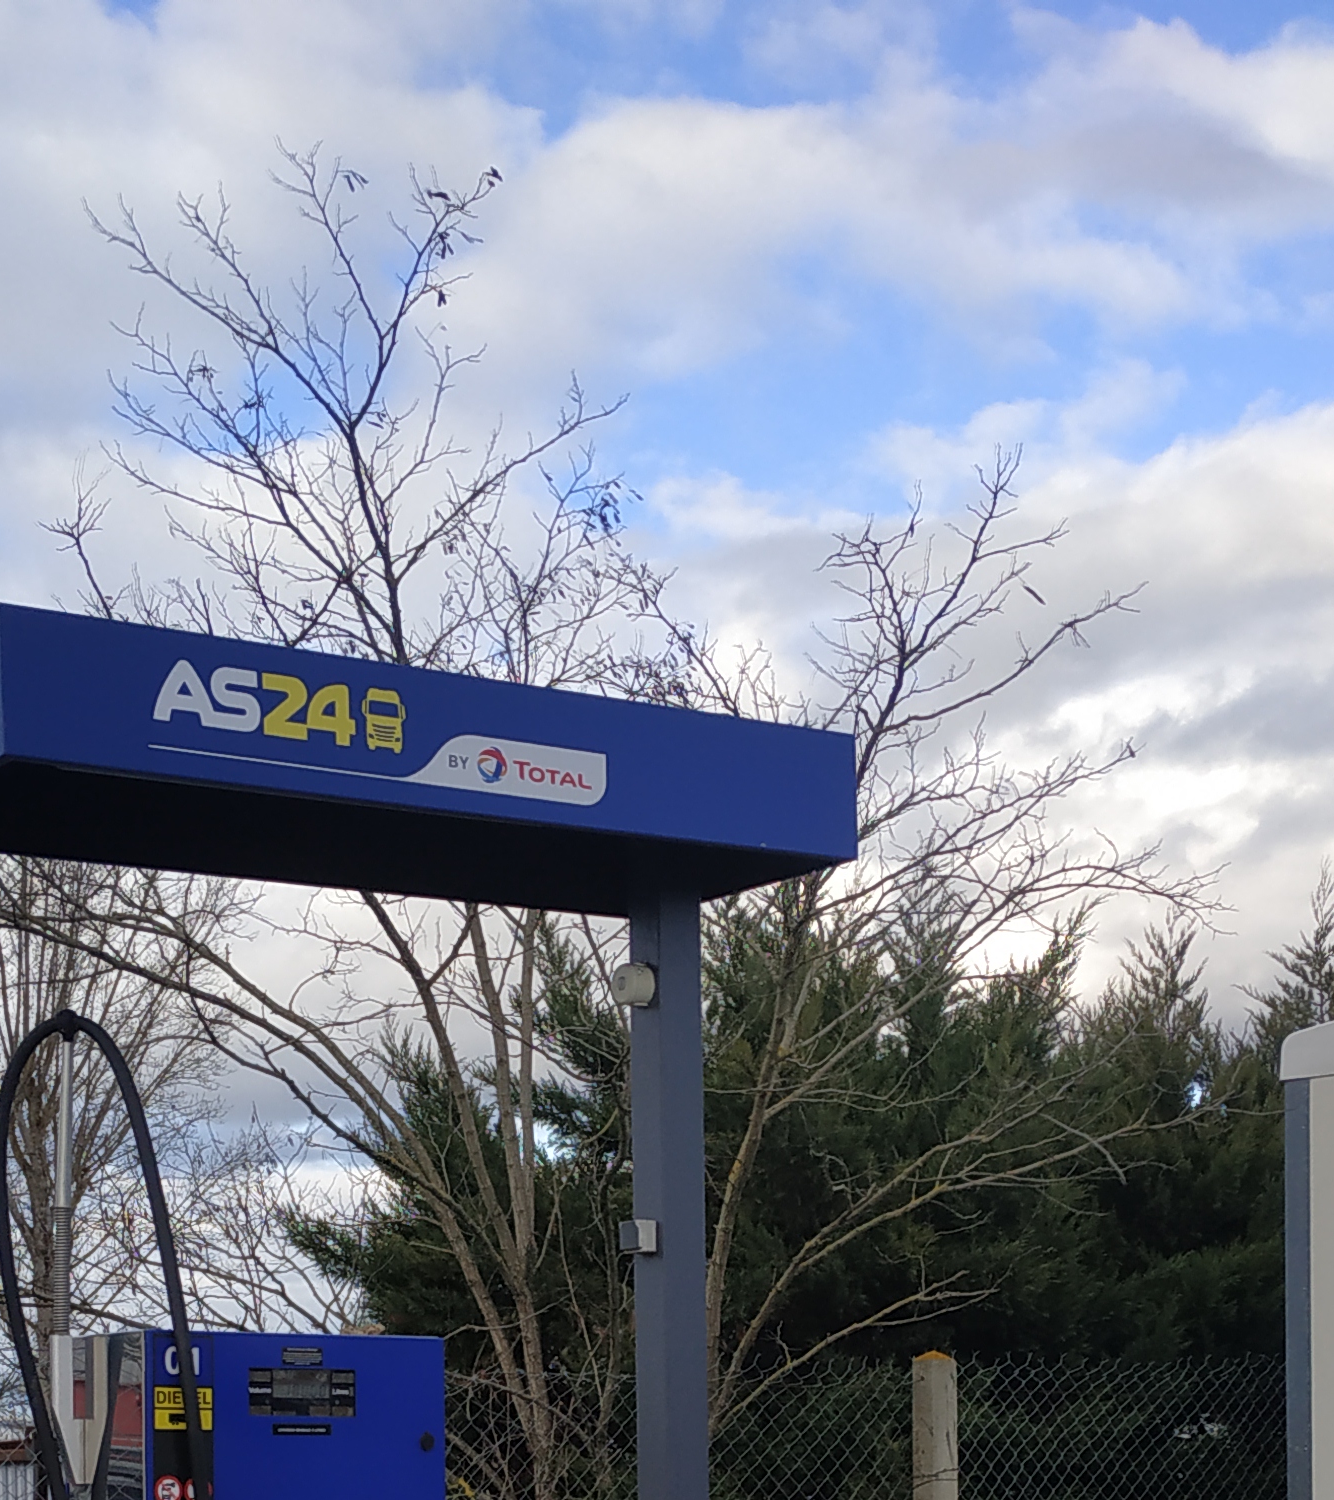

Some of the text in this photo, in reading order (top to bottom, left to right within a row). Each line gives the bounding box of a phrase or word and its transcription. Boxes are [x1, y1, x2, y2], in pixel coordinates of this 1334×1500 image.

[152, 658, 357, 747] AS24
[447, 754, 469, 770] BY
[156, 1390, 211, 1405] DIEEL
